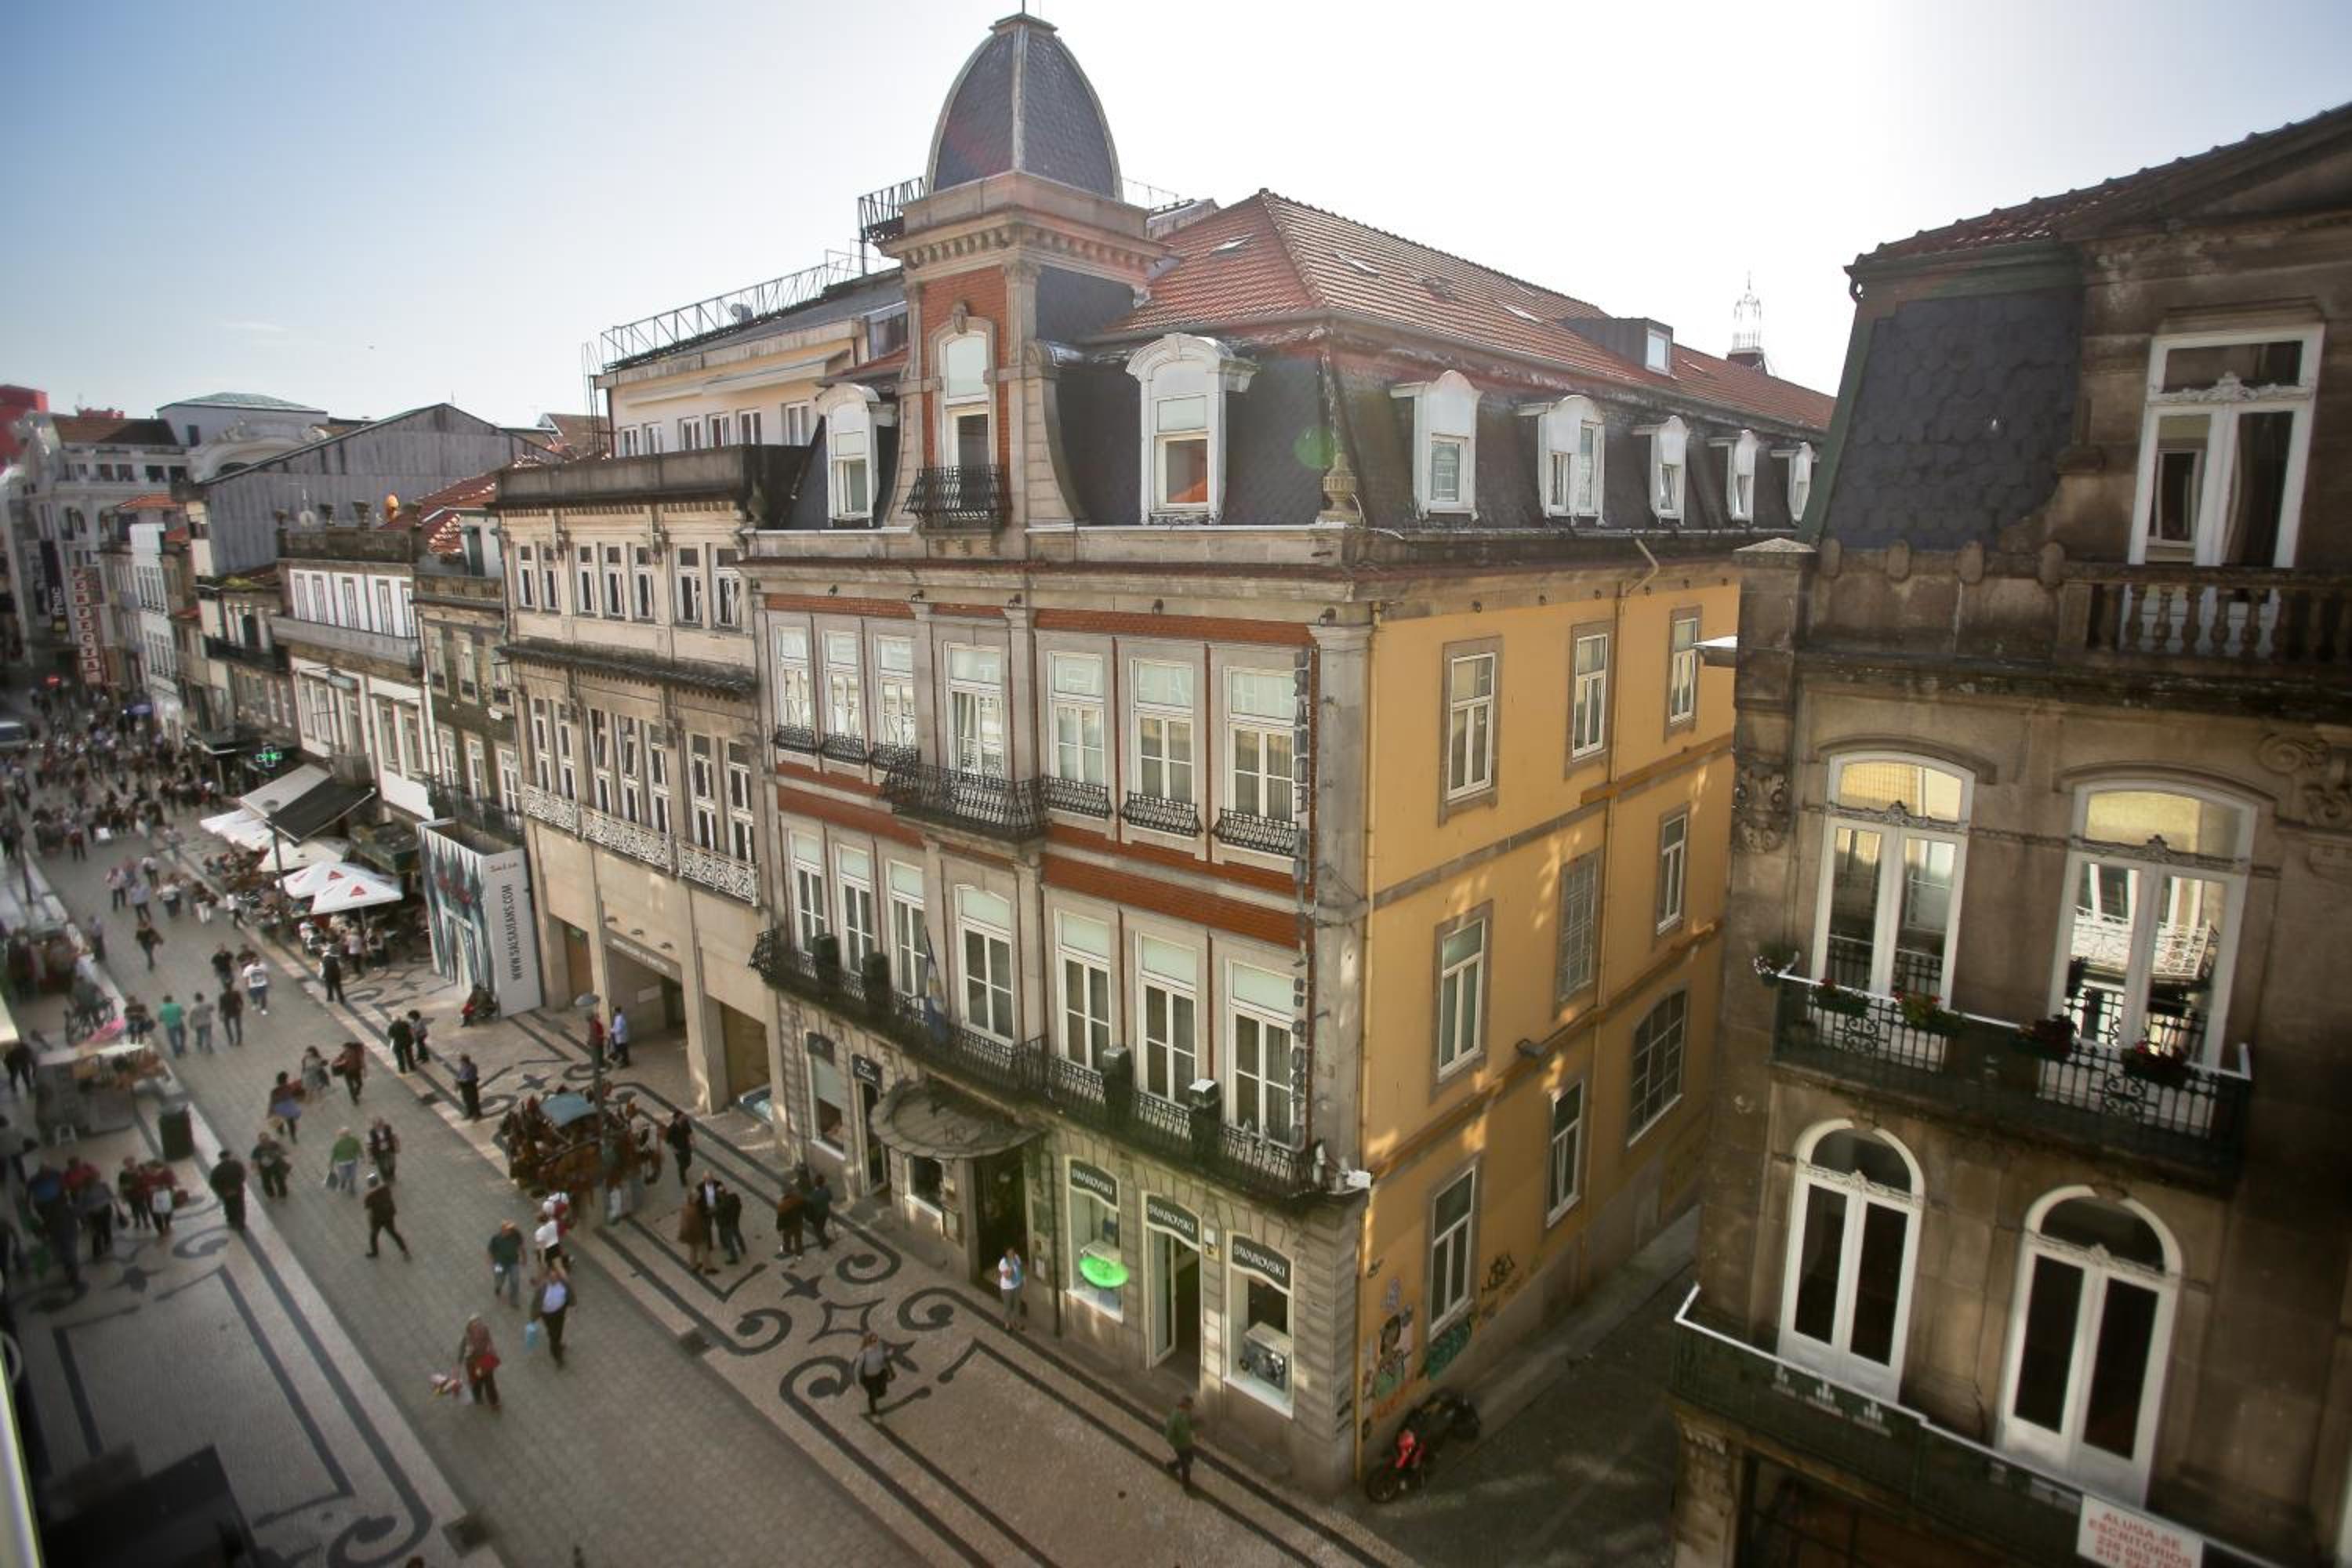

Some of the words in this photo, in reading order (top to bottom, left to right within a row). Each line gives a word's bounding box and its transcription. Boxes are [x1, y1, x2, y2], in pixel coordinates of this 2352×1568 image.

[1072, 1167, 1112, 1196] SWAROVSKI
[1148, 1203, 1194, 1234] SWAROVSKI
[1233, 1243, 1286, 1278] SWAROVSKI
